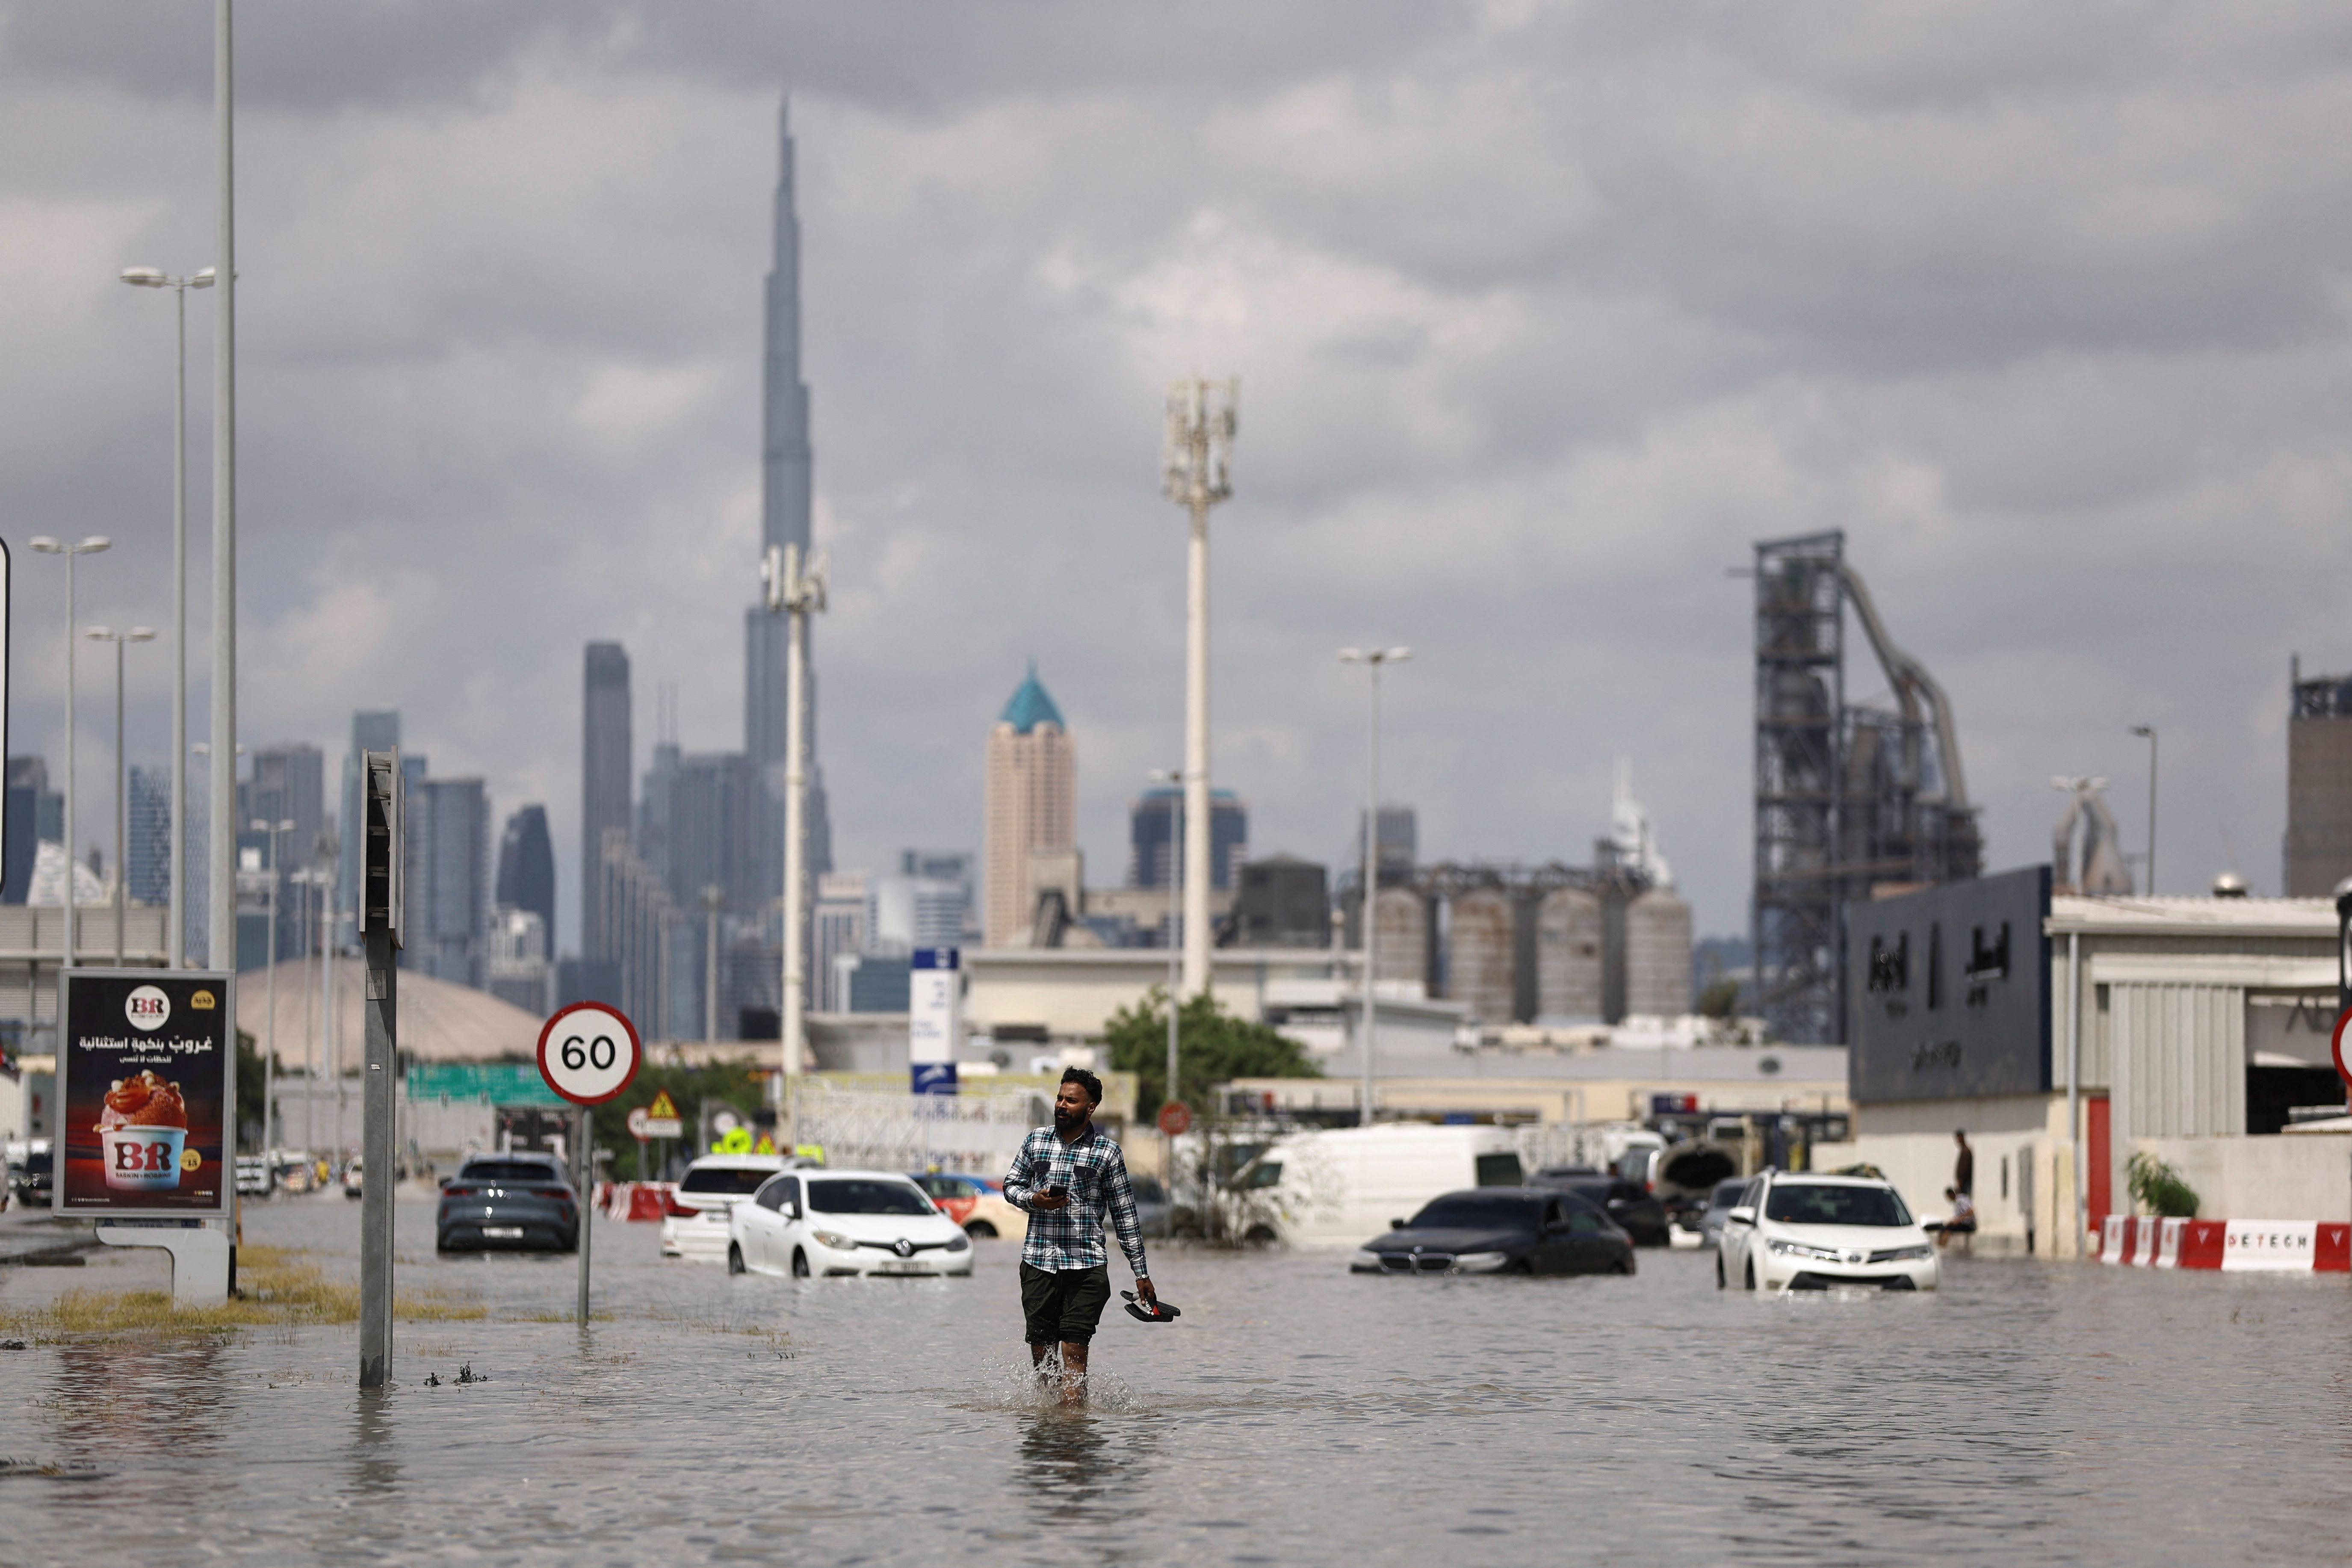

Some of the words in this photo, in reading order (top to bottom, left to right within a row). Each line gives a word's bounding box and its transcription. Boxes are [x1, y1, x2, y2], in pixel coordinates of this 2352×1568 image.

[131, 997, 164, 1013] BR
[79, 1036, 128, 1051] استثنائية
[561, 1035, 615, 1070] 60
[114, 1141, 171, 1170] BR
